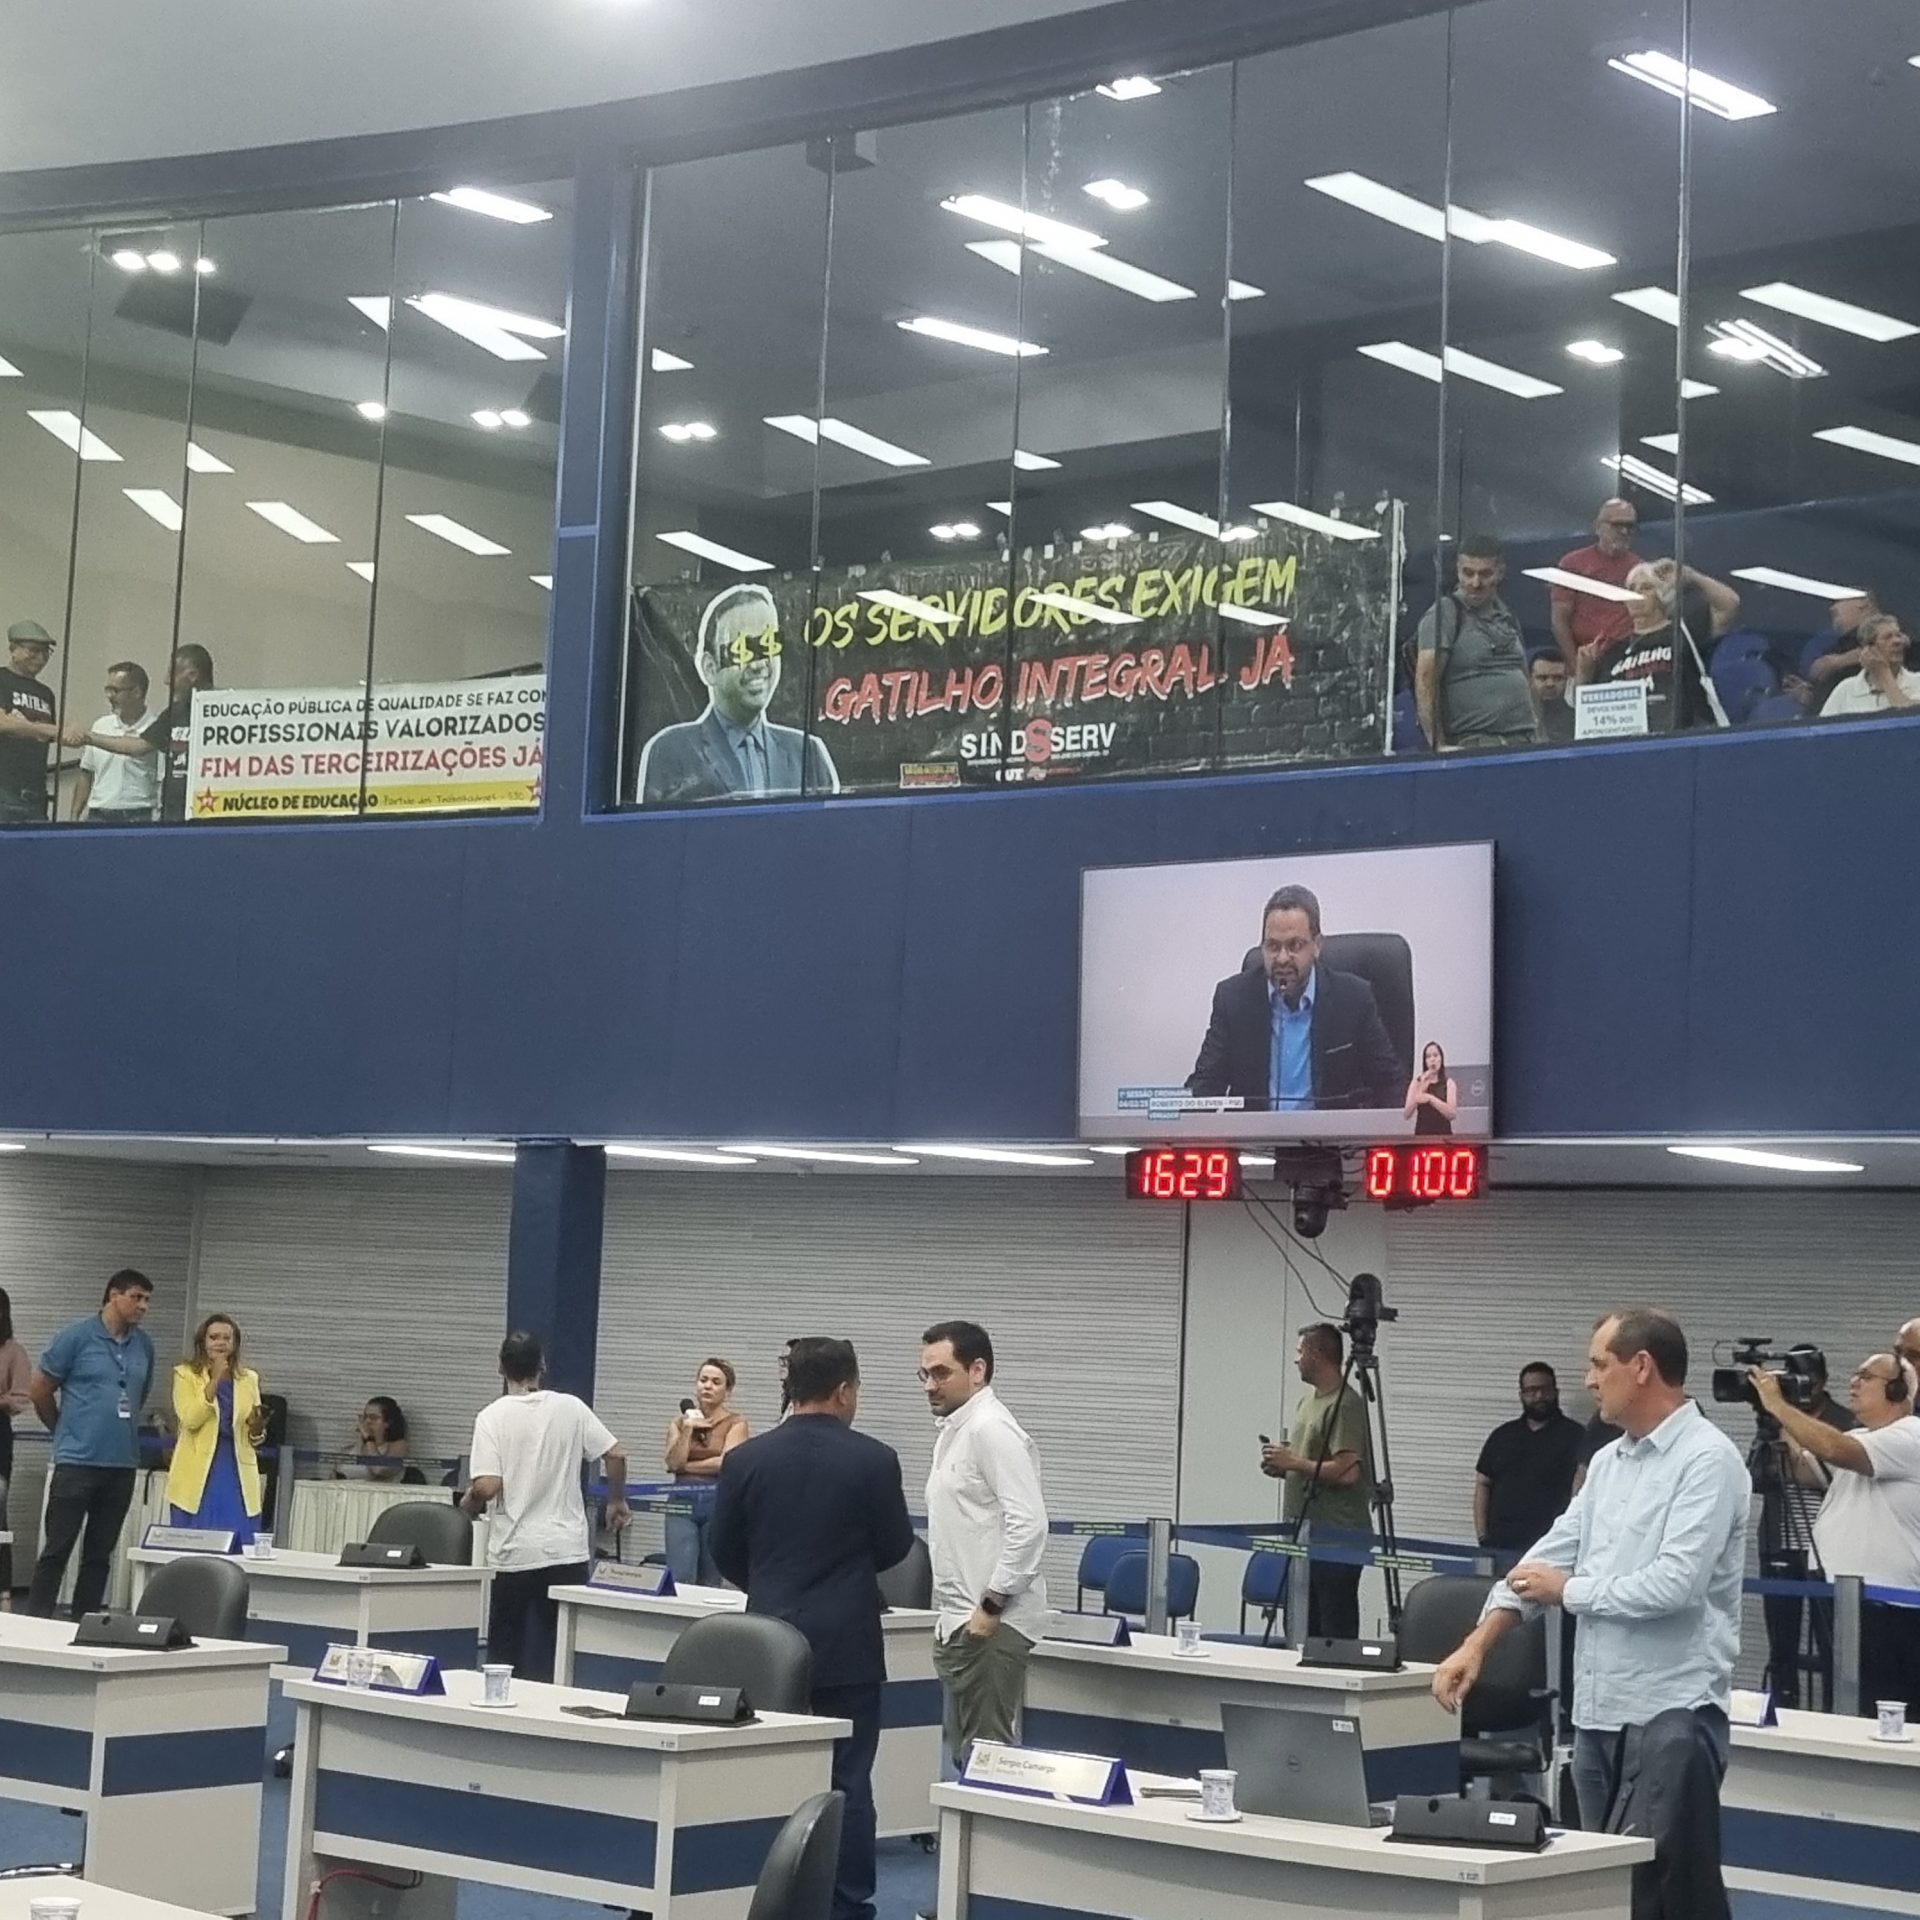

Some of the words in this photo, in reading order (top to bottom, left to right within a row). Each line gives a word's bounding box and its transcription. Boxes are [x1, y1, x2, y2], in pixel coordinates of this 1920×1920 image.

[803, 601, 860, 649] OS
[864, 574, 1126, 647] SERVIDORES
[1131, 555, 1297, 618] EXIGEM
[823, 664, 1004, 725] GATILHO
[1015, 644, 1229, 710] INTEGRAL
[1239, 624, 1295, 690] JÁ
[203, 698, 285, 720] EDUCAÇÃO
[288, 697, 354, 715] PÚBLICA
[356, 699, 375, 713] DE
[378, 694, 463, 711] QUALIDADE
[466, 692, 483, 707] SE
[487, 690, 514, 706] FAZ
[1593, 715, 1617, 726] 14%
[203, 720, 379, 746] PROFISSIONAIS
[385, 712, 546, 738] VALORIZADOS
[200, 756, 241, 778] FIM
[248, 754, 295, 776] DAS
[301, 741, 507, 777] TERCEIRIZAÇÕES
[223, 793, 279, 812] NÚCLEO
[282, 795, 300, 810] DE
